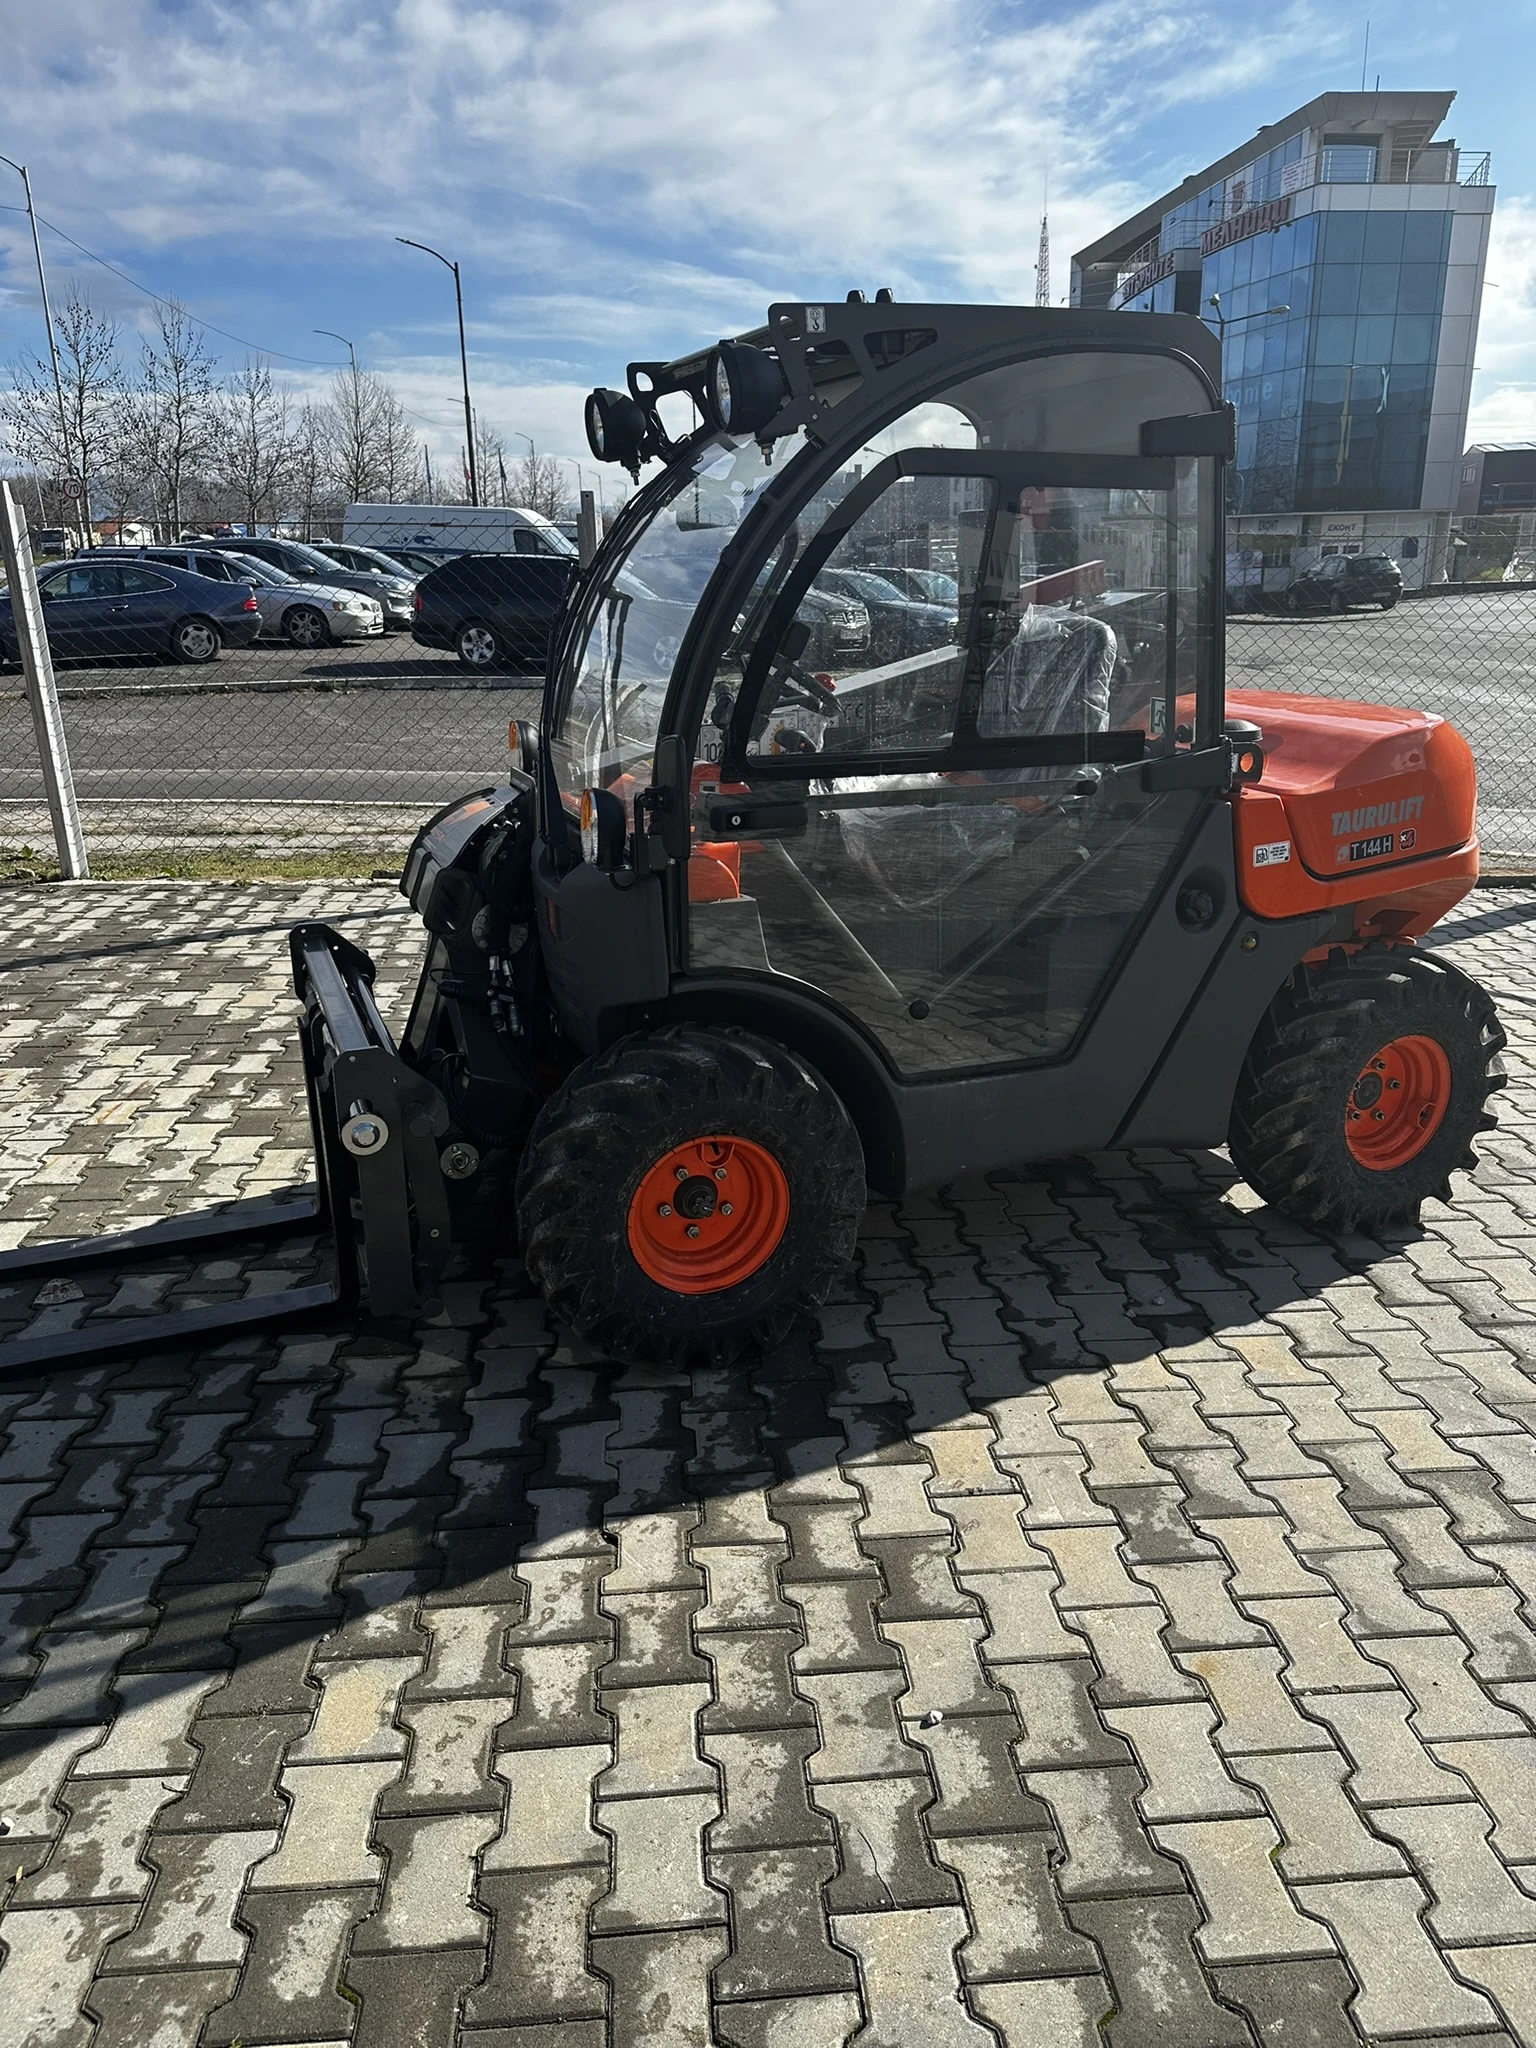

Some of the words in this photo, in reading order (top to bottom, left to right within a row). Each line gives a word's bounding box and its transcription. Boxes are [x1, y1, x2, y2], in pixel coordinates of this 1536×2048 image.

[1201, 197, 1290, 255] МЕЛНИЦИ
[69, 484, 79, 494] 70
[1327, 523, 1358, 532] ЕКОНТ
[1331, 795, 1425, 837] TAURULIFT
